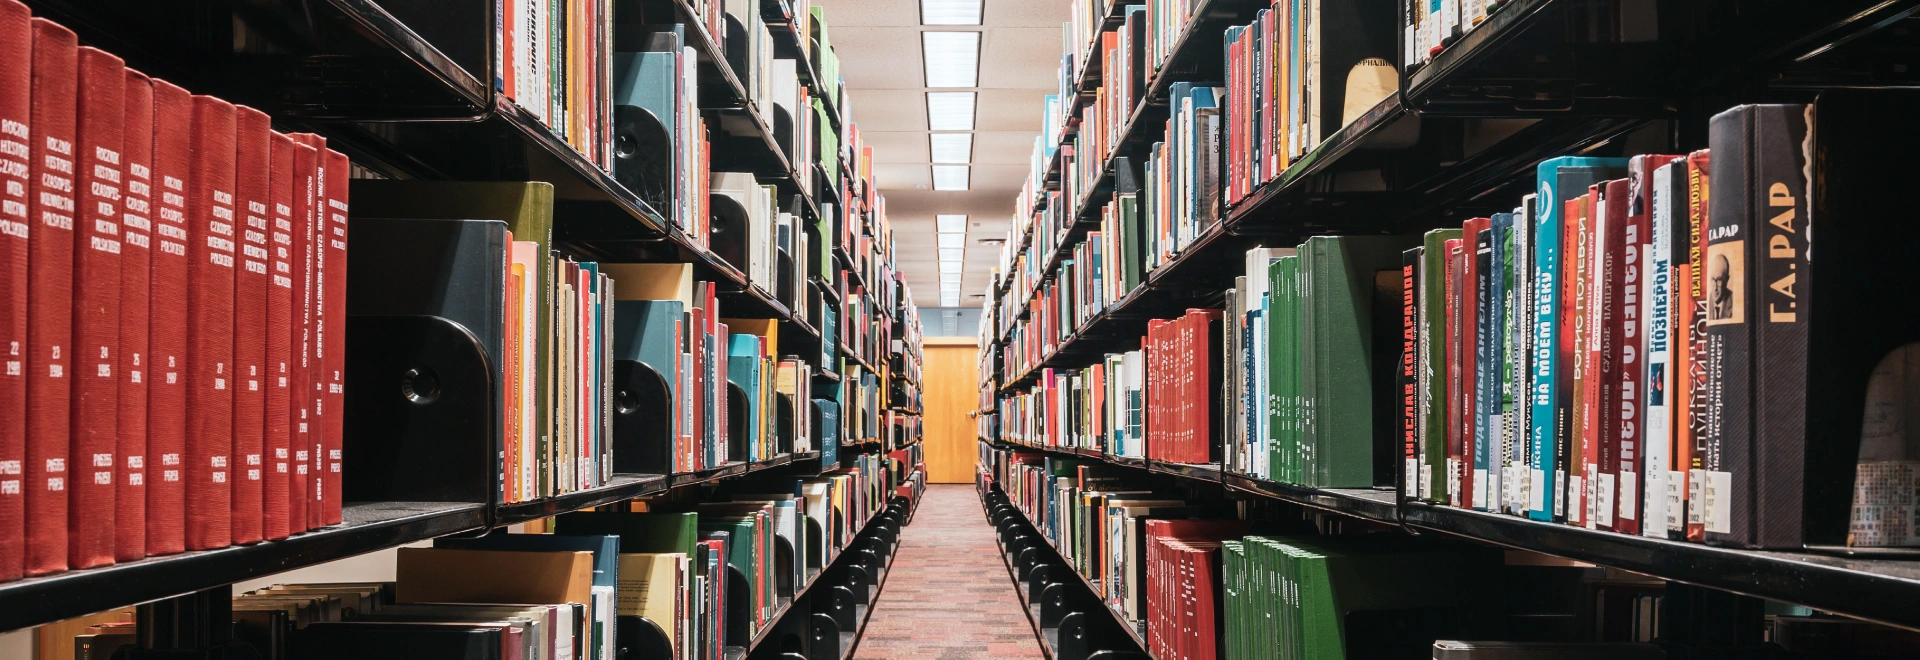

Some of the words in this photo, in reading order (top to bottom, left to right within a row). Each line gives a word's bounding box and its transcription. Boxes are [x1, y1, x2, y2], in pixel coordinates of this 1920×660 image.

[1691, 168, 1700, 214] ЛЮБВИ
[1692, 217, 1700, 244] СИЛА
[1577, 217, 1586, 310] ПОЛЕВОЙ
[1624, 224, 1637, 338] ПОЗНЕР
[1692, 248, 1700, 297] ВЕЛИКАЯ
[1404, 264, 1414, 376] КОНДРАШОВ
[1654, 259, 1668, 352] ПОЗНЕРОМ
[1540, 321, 1551, 376] МОЕМ
[1476, 361, 1484, 462] ПОДОБНЫЕ
[1503, 381, 1511, 396] Я
[1539, 382, 1549, 405] НА
[1715, 381, 1723, 436] истории
[1406, 384, 1414, 459] НИСЛАВ
